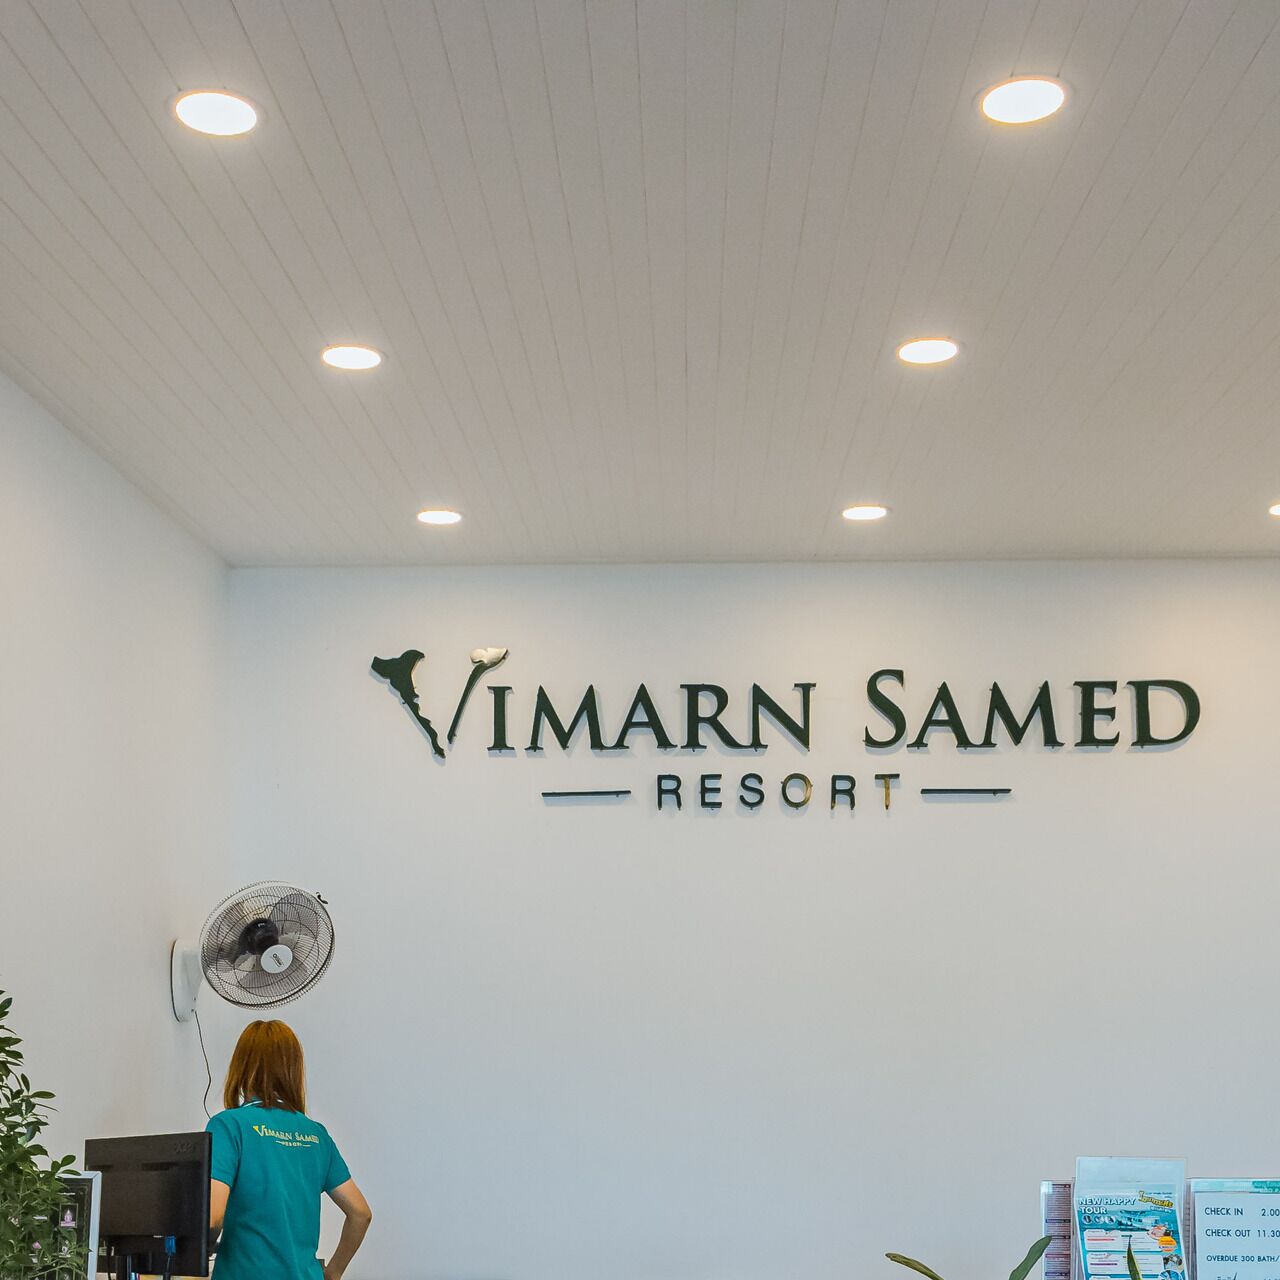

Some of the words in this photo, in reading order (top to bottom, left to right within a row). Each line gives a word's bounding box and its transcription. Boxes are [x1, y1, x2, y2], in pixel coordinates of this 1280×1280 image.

[371, 647, 818, 759] VIMARN
[864, 668, 1202, 754] SAMED
[656, 773, 902, 811] RESORT
[1079, 1197, 1102, 1206] NEW
[1103, 1197, 1136, 1206] HAPPY
[1080, 1206, 1107, 1214] TOUR
[1204, 1207, 1232, 1216] CHECK
[1234, 1207, 1244, 1216] IN
[1261, 1208, 1280, 1217] 2.00
[1205, 1228, 1232, 1237] CHECK
[1234, 1229, 1251, 1238] OUT
[1257, 1230, 1280, 1238] 11.30
